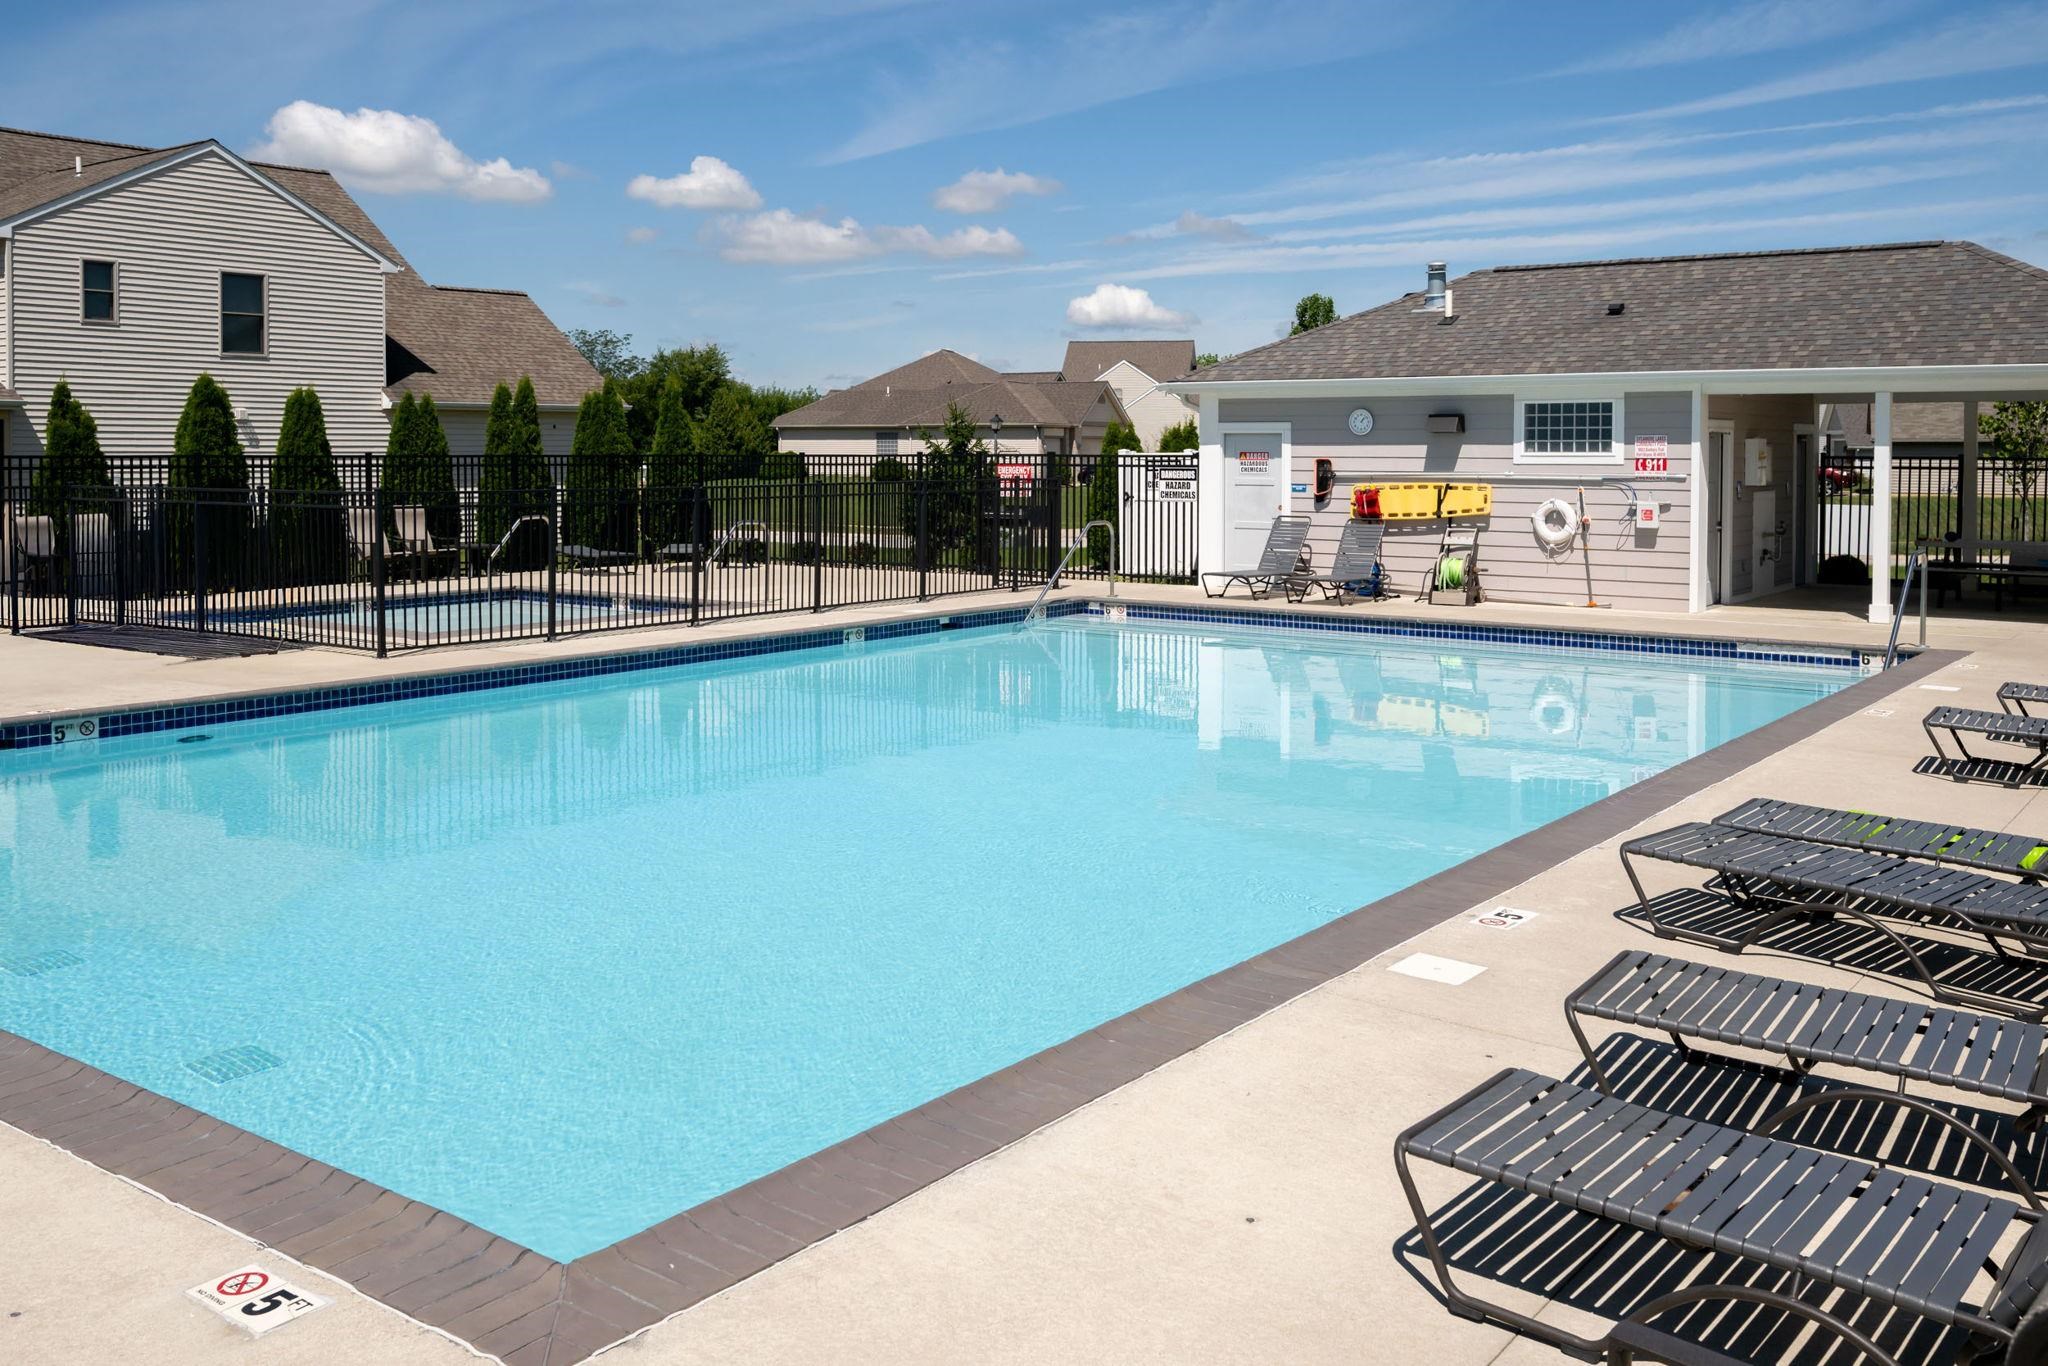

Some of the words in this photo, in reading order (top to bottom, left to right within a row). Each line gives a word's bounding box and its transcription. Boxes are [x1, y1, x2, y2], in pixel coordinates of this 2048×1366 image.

[997, 465, 1031, 475] EMERGENCY
[1646, 459, 1664, 471] 911
[1160, 470, 1196, 480] DANGEROUS
[1165, 482, 1191, 490] HAZARD
[1160, 491, 1196, 499] CHEMICALS
[844, 631, 850, 643] 4
[1861, 653, 1871, 665] 6
[54, 725, 66, 741] 5
[1494, 912, 1524, 920] 5
[241, 1289, 299, 1316] 5
[287, 1298, 314, 1311] FT
